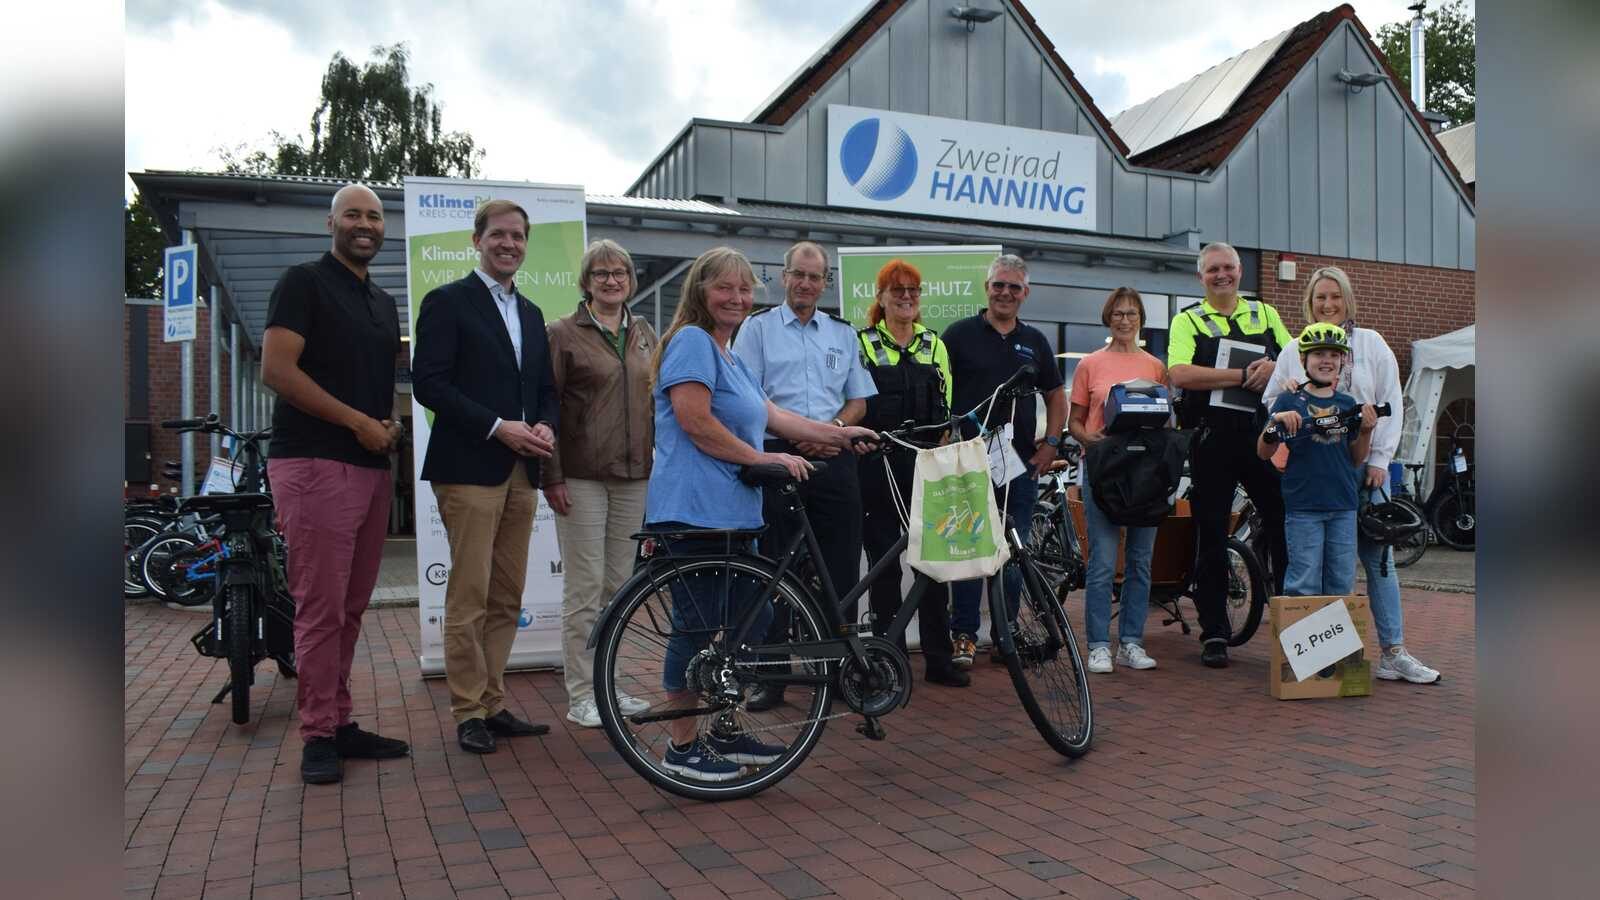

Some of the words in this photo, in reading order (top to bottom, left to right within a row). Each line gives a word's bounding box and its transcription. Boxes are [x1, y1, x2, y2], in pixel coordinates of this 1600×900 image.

[936, 139, 1061, 180] Zweirad
[419, 194, 491, 209] KlimaP
[929, 171, 1086, 215] HANNING
[422, 245, 481, 261] KlimaPa
[173, 259, 189, 300] P
[545, 271, 576, 287] MIT.
[853, 281, 972, 298] KLICHUTZ
[1294, 643, 1308, 656] 2.
[1309, 623, 1344, 647] Preis
